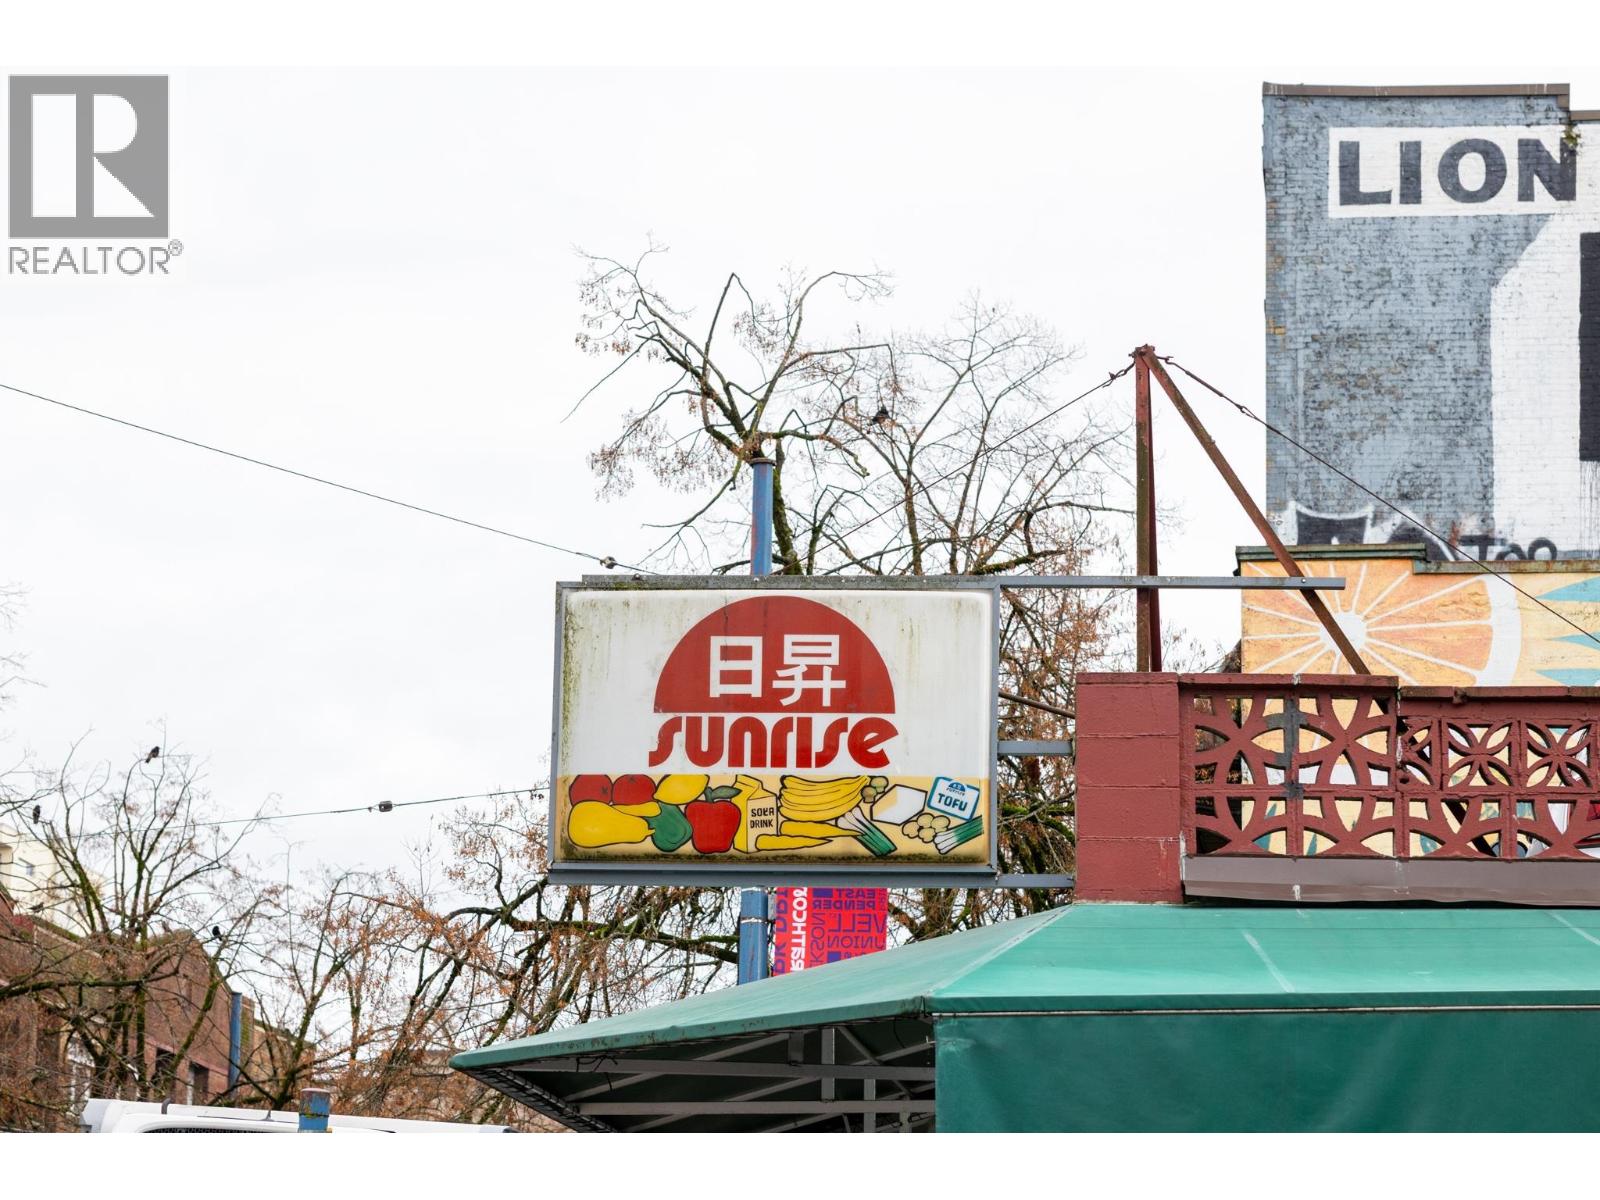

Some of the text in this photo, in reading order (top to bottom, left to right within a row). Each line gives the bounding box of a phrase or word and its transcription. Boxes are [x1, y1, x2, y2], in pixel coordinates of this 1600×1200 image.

[1338, 138, 1577, 206] LION
[708, 634, 847, 707] 日昇
[938, 792, 968, 811] TOFU
[749, 818, 774, 829] DRINK
